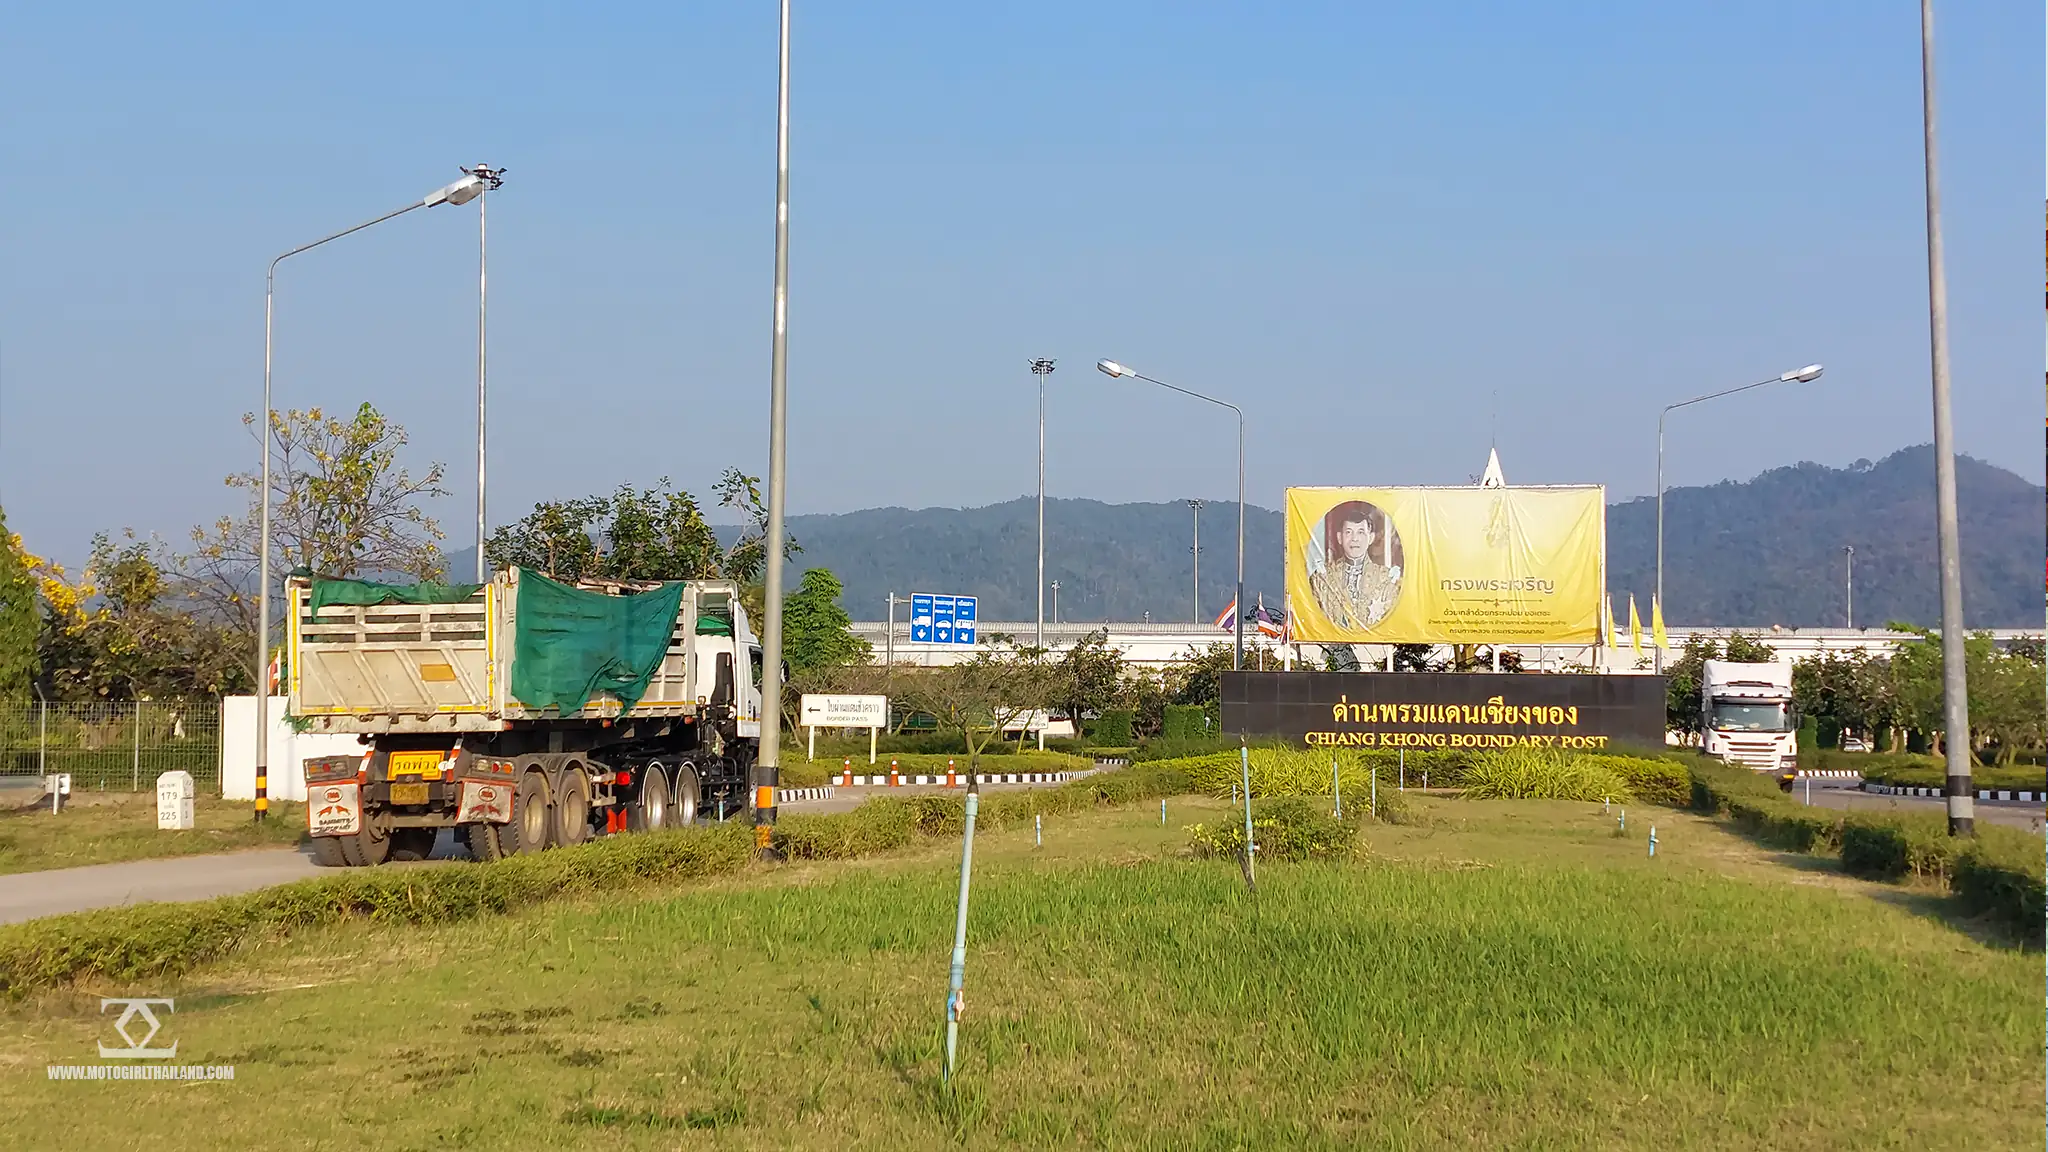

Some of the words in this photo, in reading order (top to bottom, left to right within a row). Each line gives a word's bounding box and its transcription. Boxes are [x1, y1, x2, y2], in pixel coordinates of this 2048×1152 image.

[1441, 576, 1554, 594] ทรงพระเจริญ
[1333, 695, 1579, 725] ด่านพรมแดนเชียงของ
[1304, 731, 1376, 746] CHIANG
[1379, 732, 1447, 747] KHONG
[1450, 733, 1557, 748] BOUNDARY
[1560, 735, 1608, 749] POST
[395, 757, 438, 770] รถพ่วง
[161, 791, 178, 801] 179
[160, 811, 177, 821] 225
